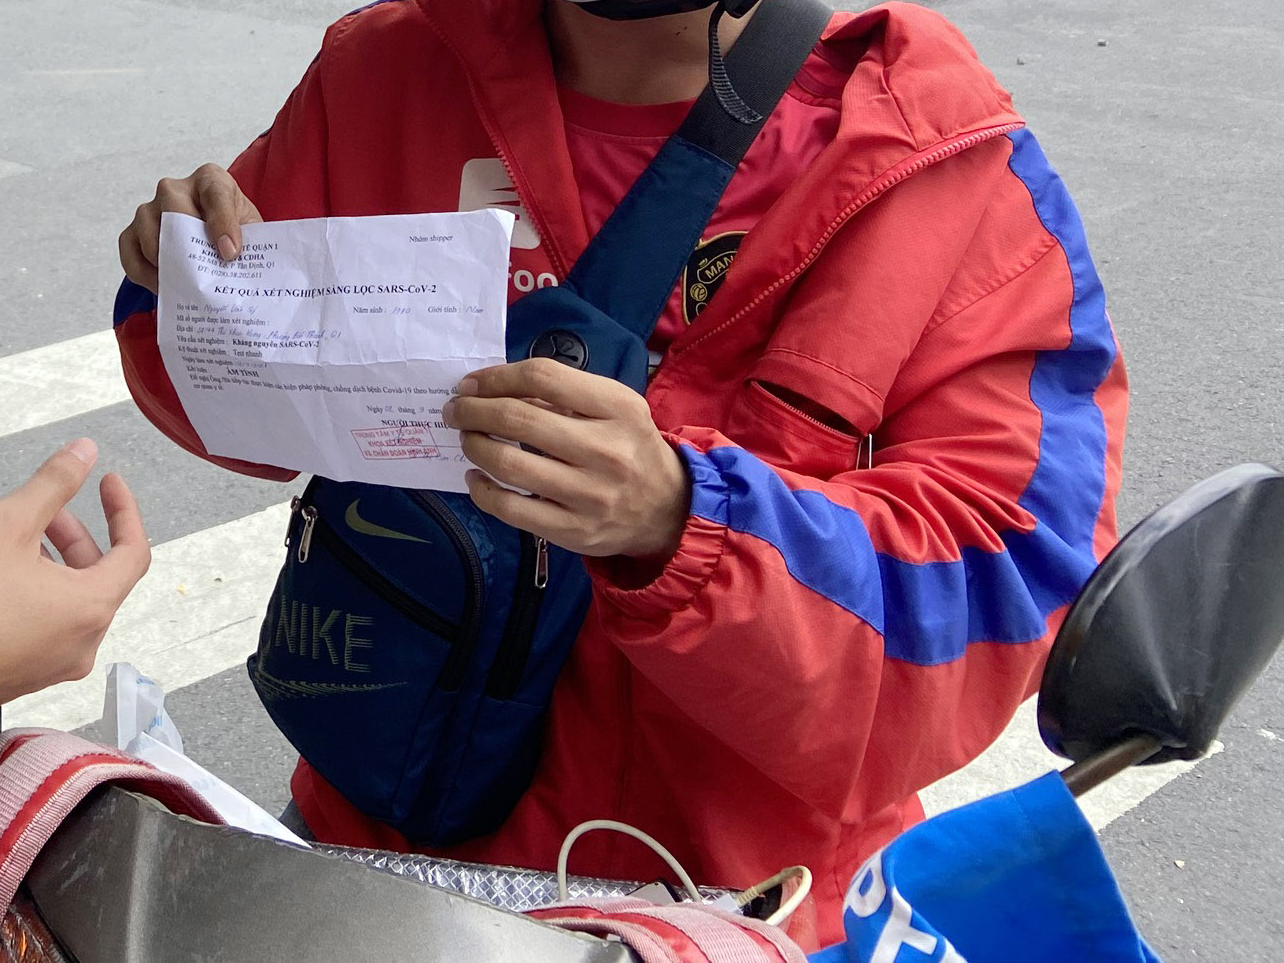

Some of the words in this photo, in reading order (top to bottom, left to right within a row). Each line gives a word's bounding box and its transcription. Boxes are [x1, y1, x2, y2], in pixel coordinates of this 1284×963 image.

[430, 235, 453, 243] shipper
[252, 243, 273, 253] QUẬN
[266, 261, 275, 269] Q1
[509, 258, 558, 293] oo
[214, 285, 236, 295] KẾT
[238, 287, 260, 297] QUẢ
[261, 287, 284, 297] XÉT
[284, 287, 325, 299] NGHIỆM
[326, 284, 350, 295] SÀNG
[353, 284, 376, 297] LỌC
[377, 284, 437, 295] SARS-CoV-2
[353, 305, 368, 314] Năm
[428, 305, 442, 314] Giới
[232, 339, 252, 347] Kháng
[233, 349, 244, 357] Test
[240, 369, 260, 377] TÍNH
[382, 387, 412, 395] Covid-19
[414, 387, 428, 395] theo
[367, 405, 383, 413] Ngày
[398, 407, 416, 415] tháng
[275, 594, 374, 673] NIKE
